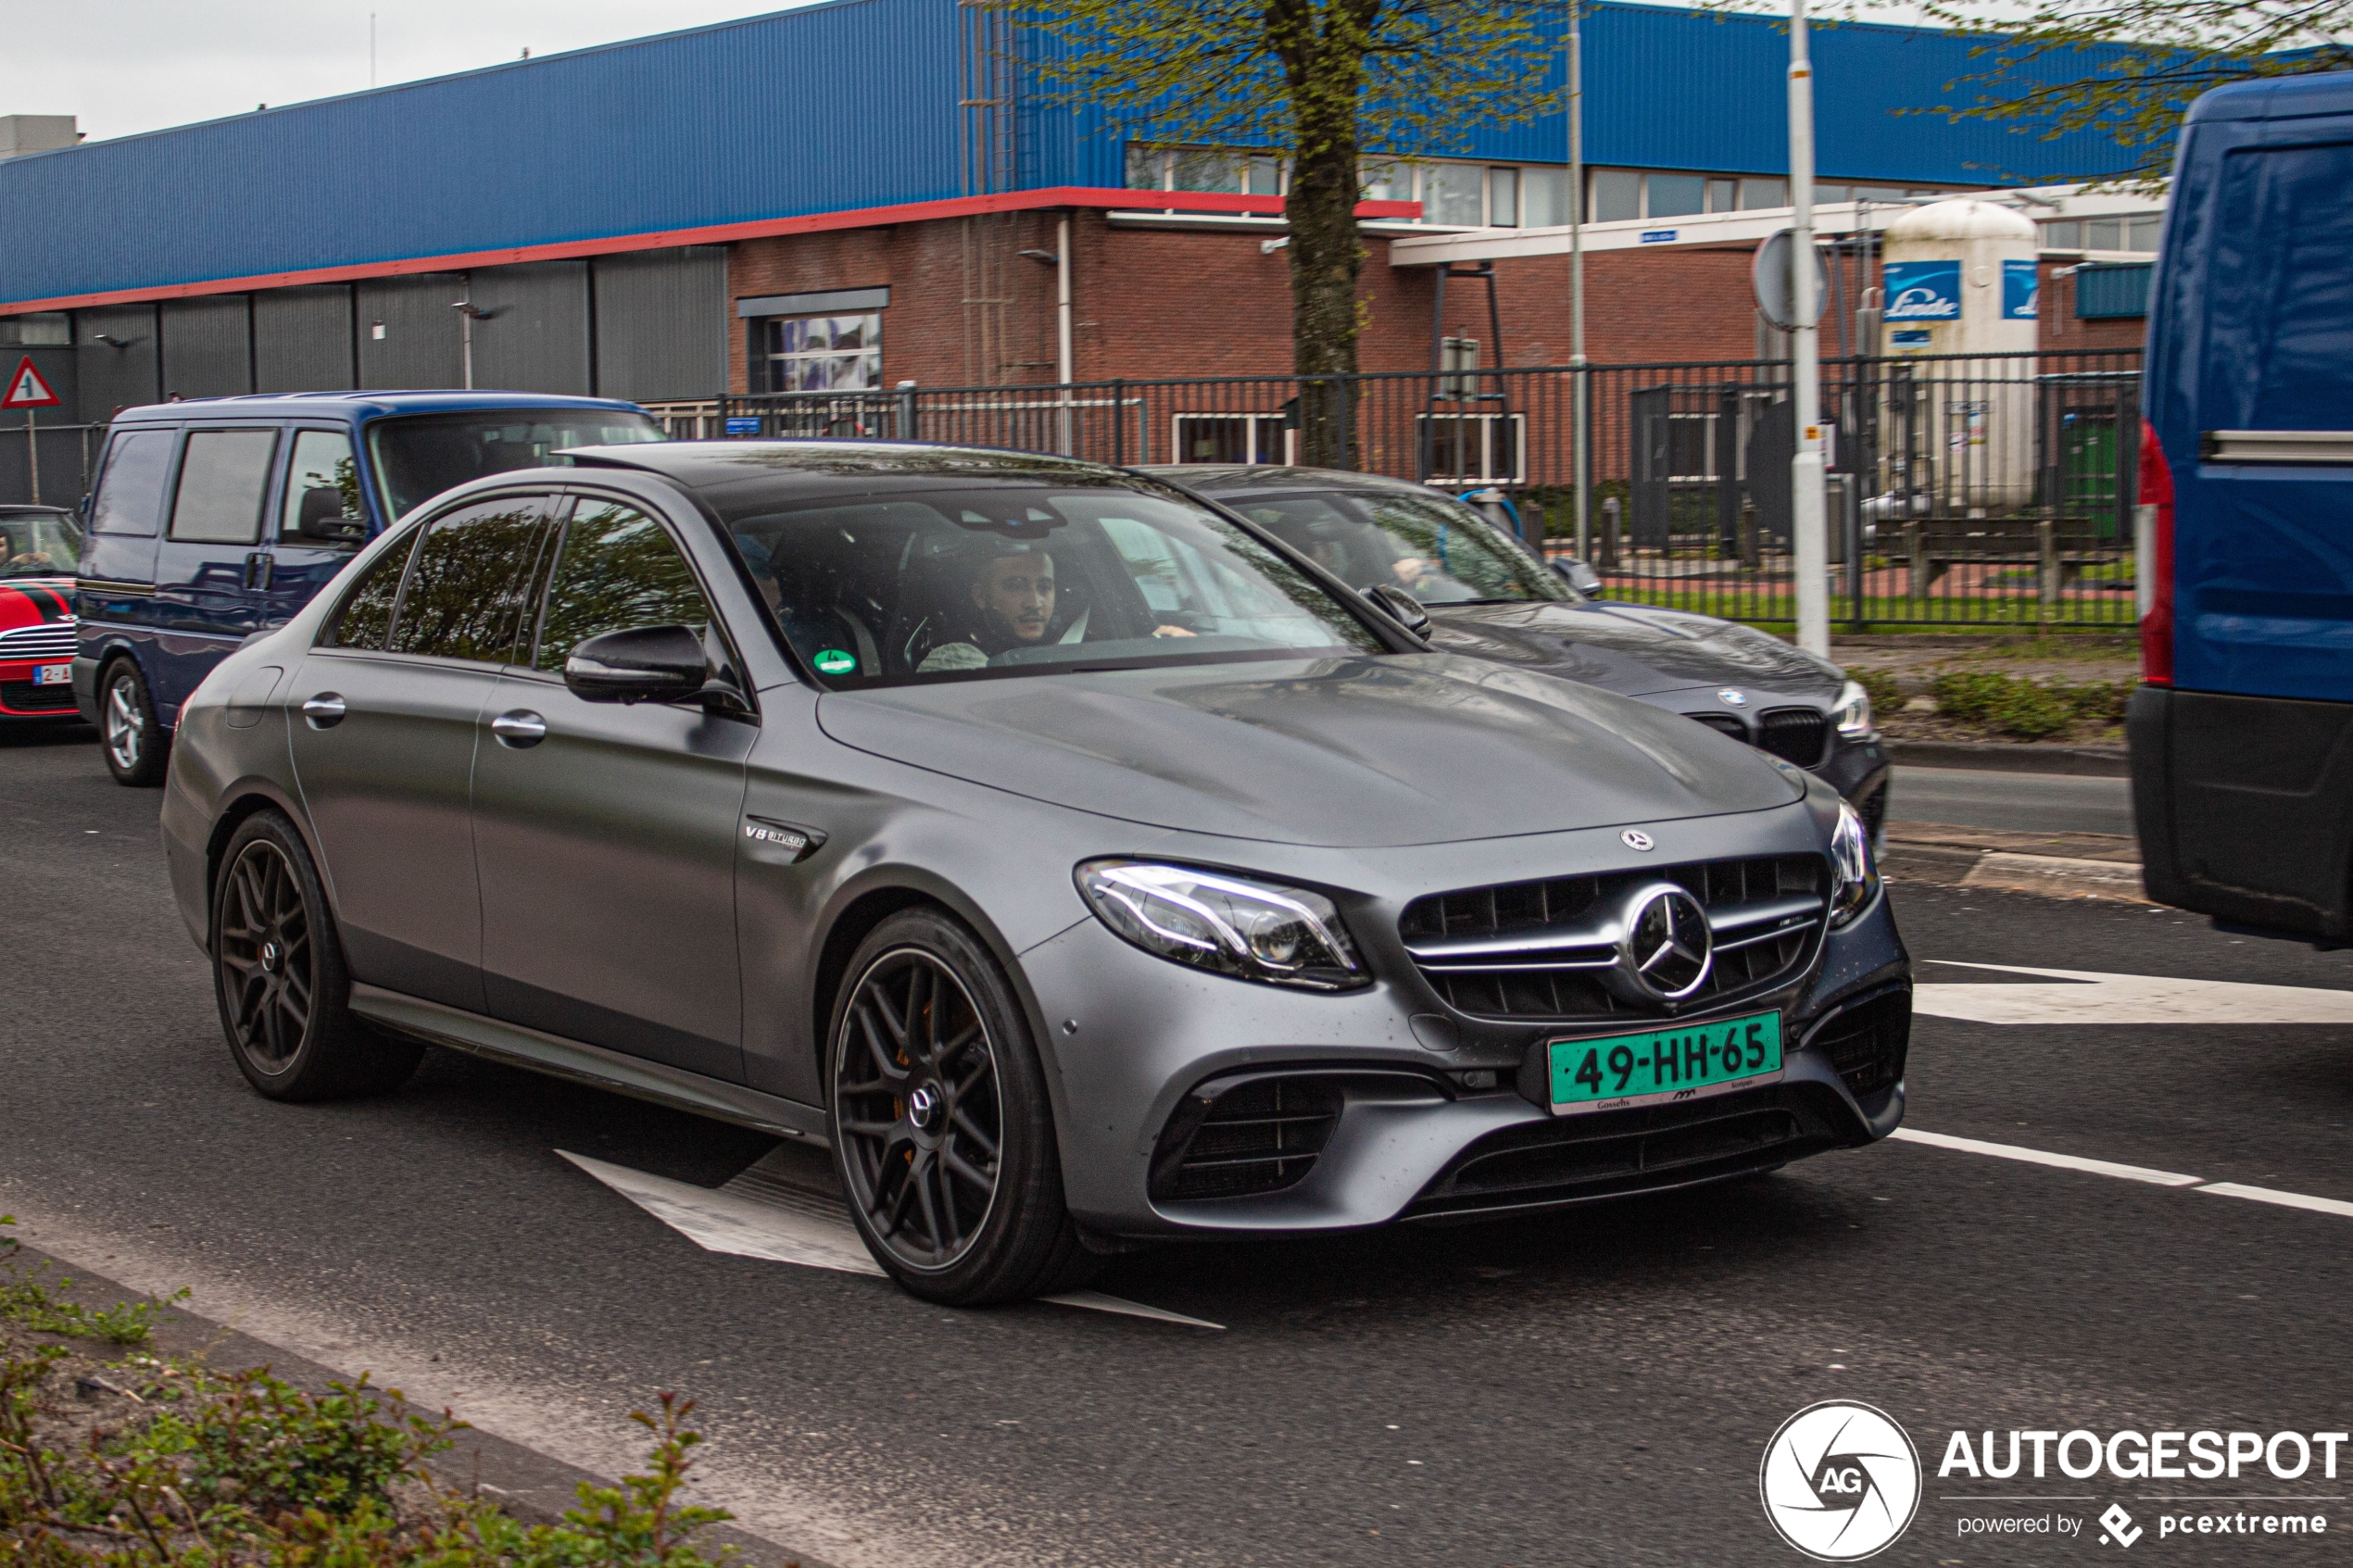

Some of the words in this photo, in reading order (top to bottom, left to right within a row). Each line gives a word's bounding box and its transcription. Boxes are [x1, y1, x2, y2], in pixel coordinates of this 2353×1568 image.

[1883, 288, 1959, 318] Linde
[746, 825, 768, 840] V8
[768, 831, 807, 847] BITURBO
[1576, 1023, 1765, 1094] 49-HH-65
